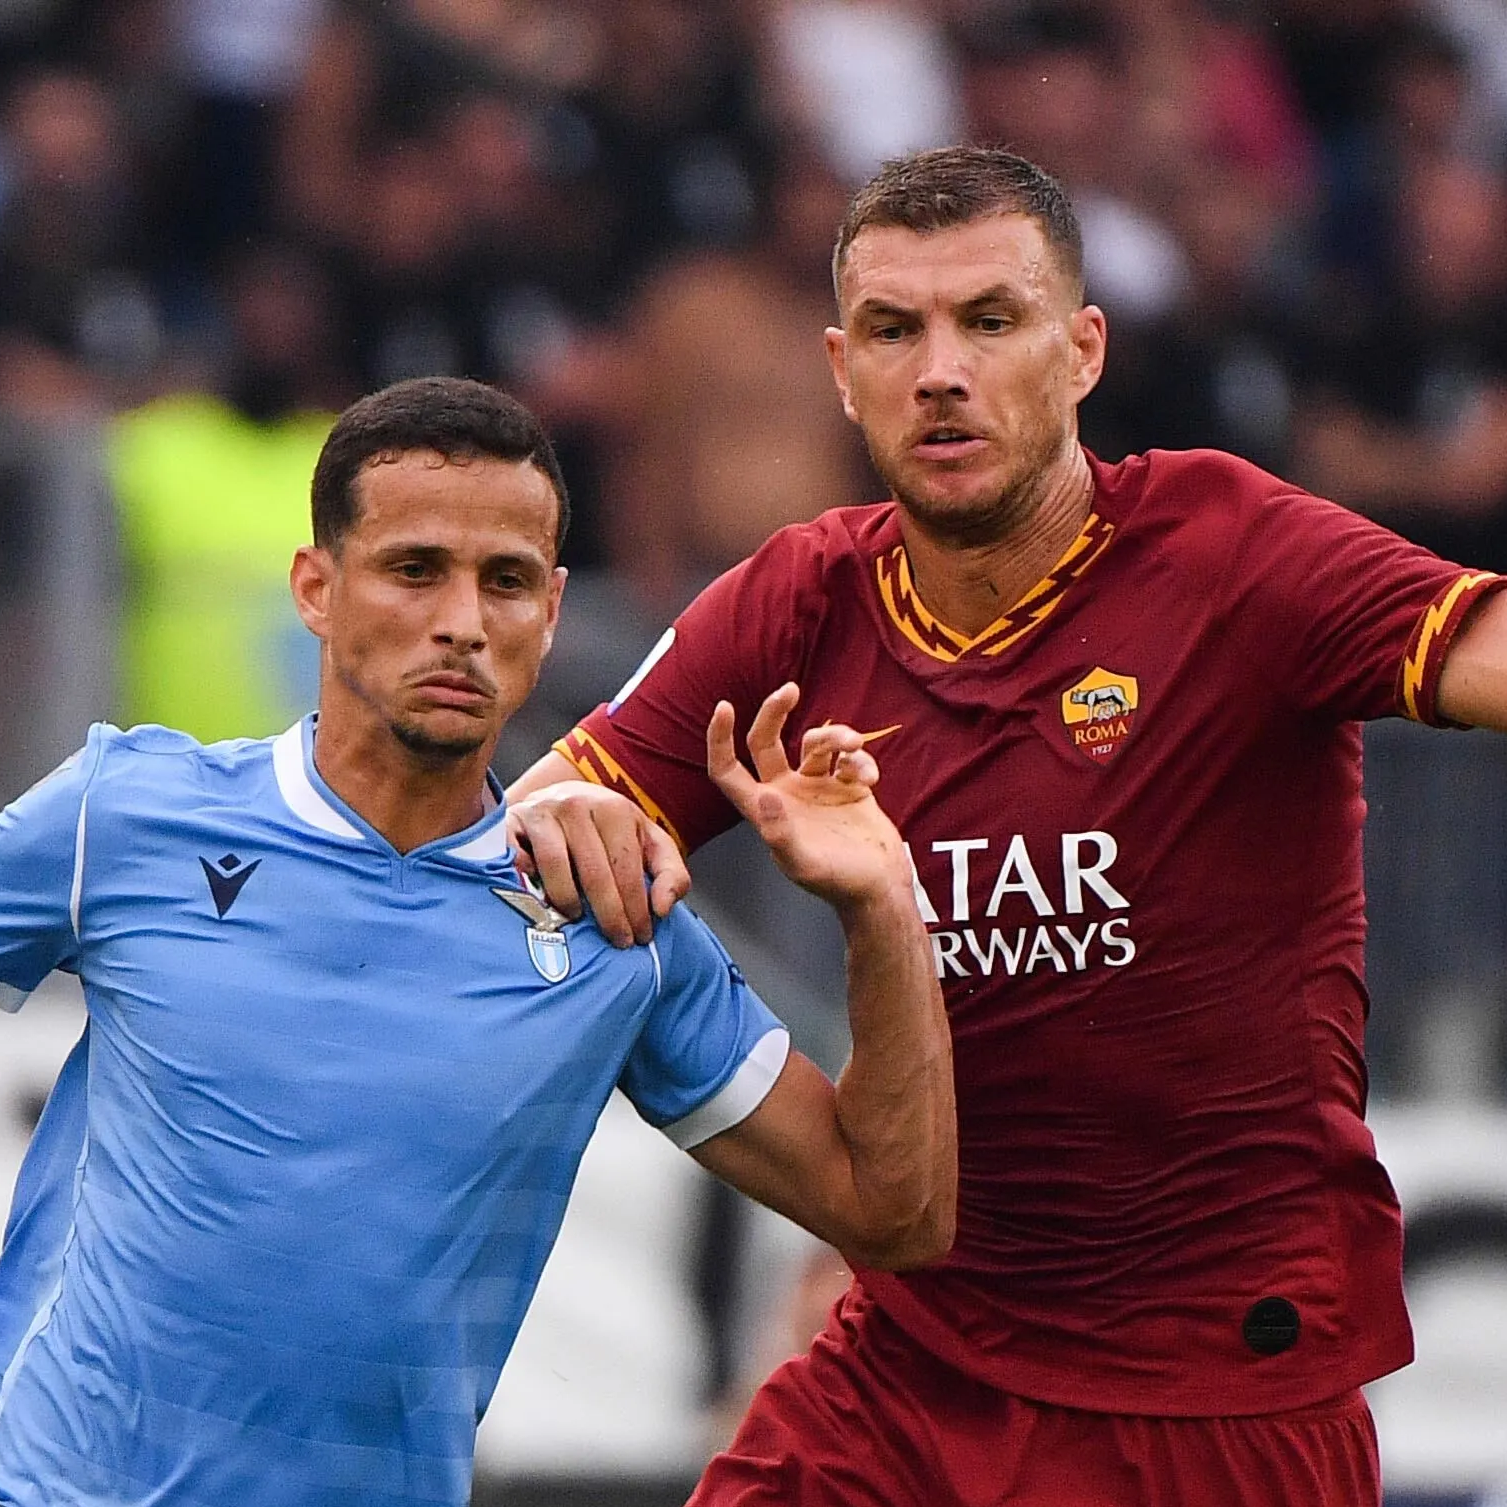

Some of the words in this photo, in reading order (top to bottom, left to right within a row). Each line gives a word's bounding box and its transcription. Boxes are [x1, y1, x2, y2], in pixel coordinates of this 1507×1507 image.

[1074, 720, 1129, 745] ROMA
[1092, 743, 1113, 756] 1927
[902, 830, 1131, 923] ATAR
[929, 918, 1137, 979] RWAYS
